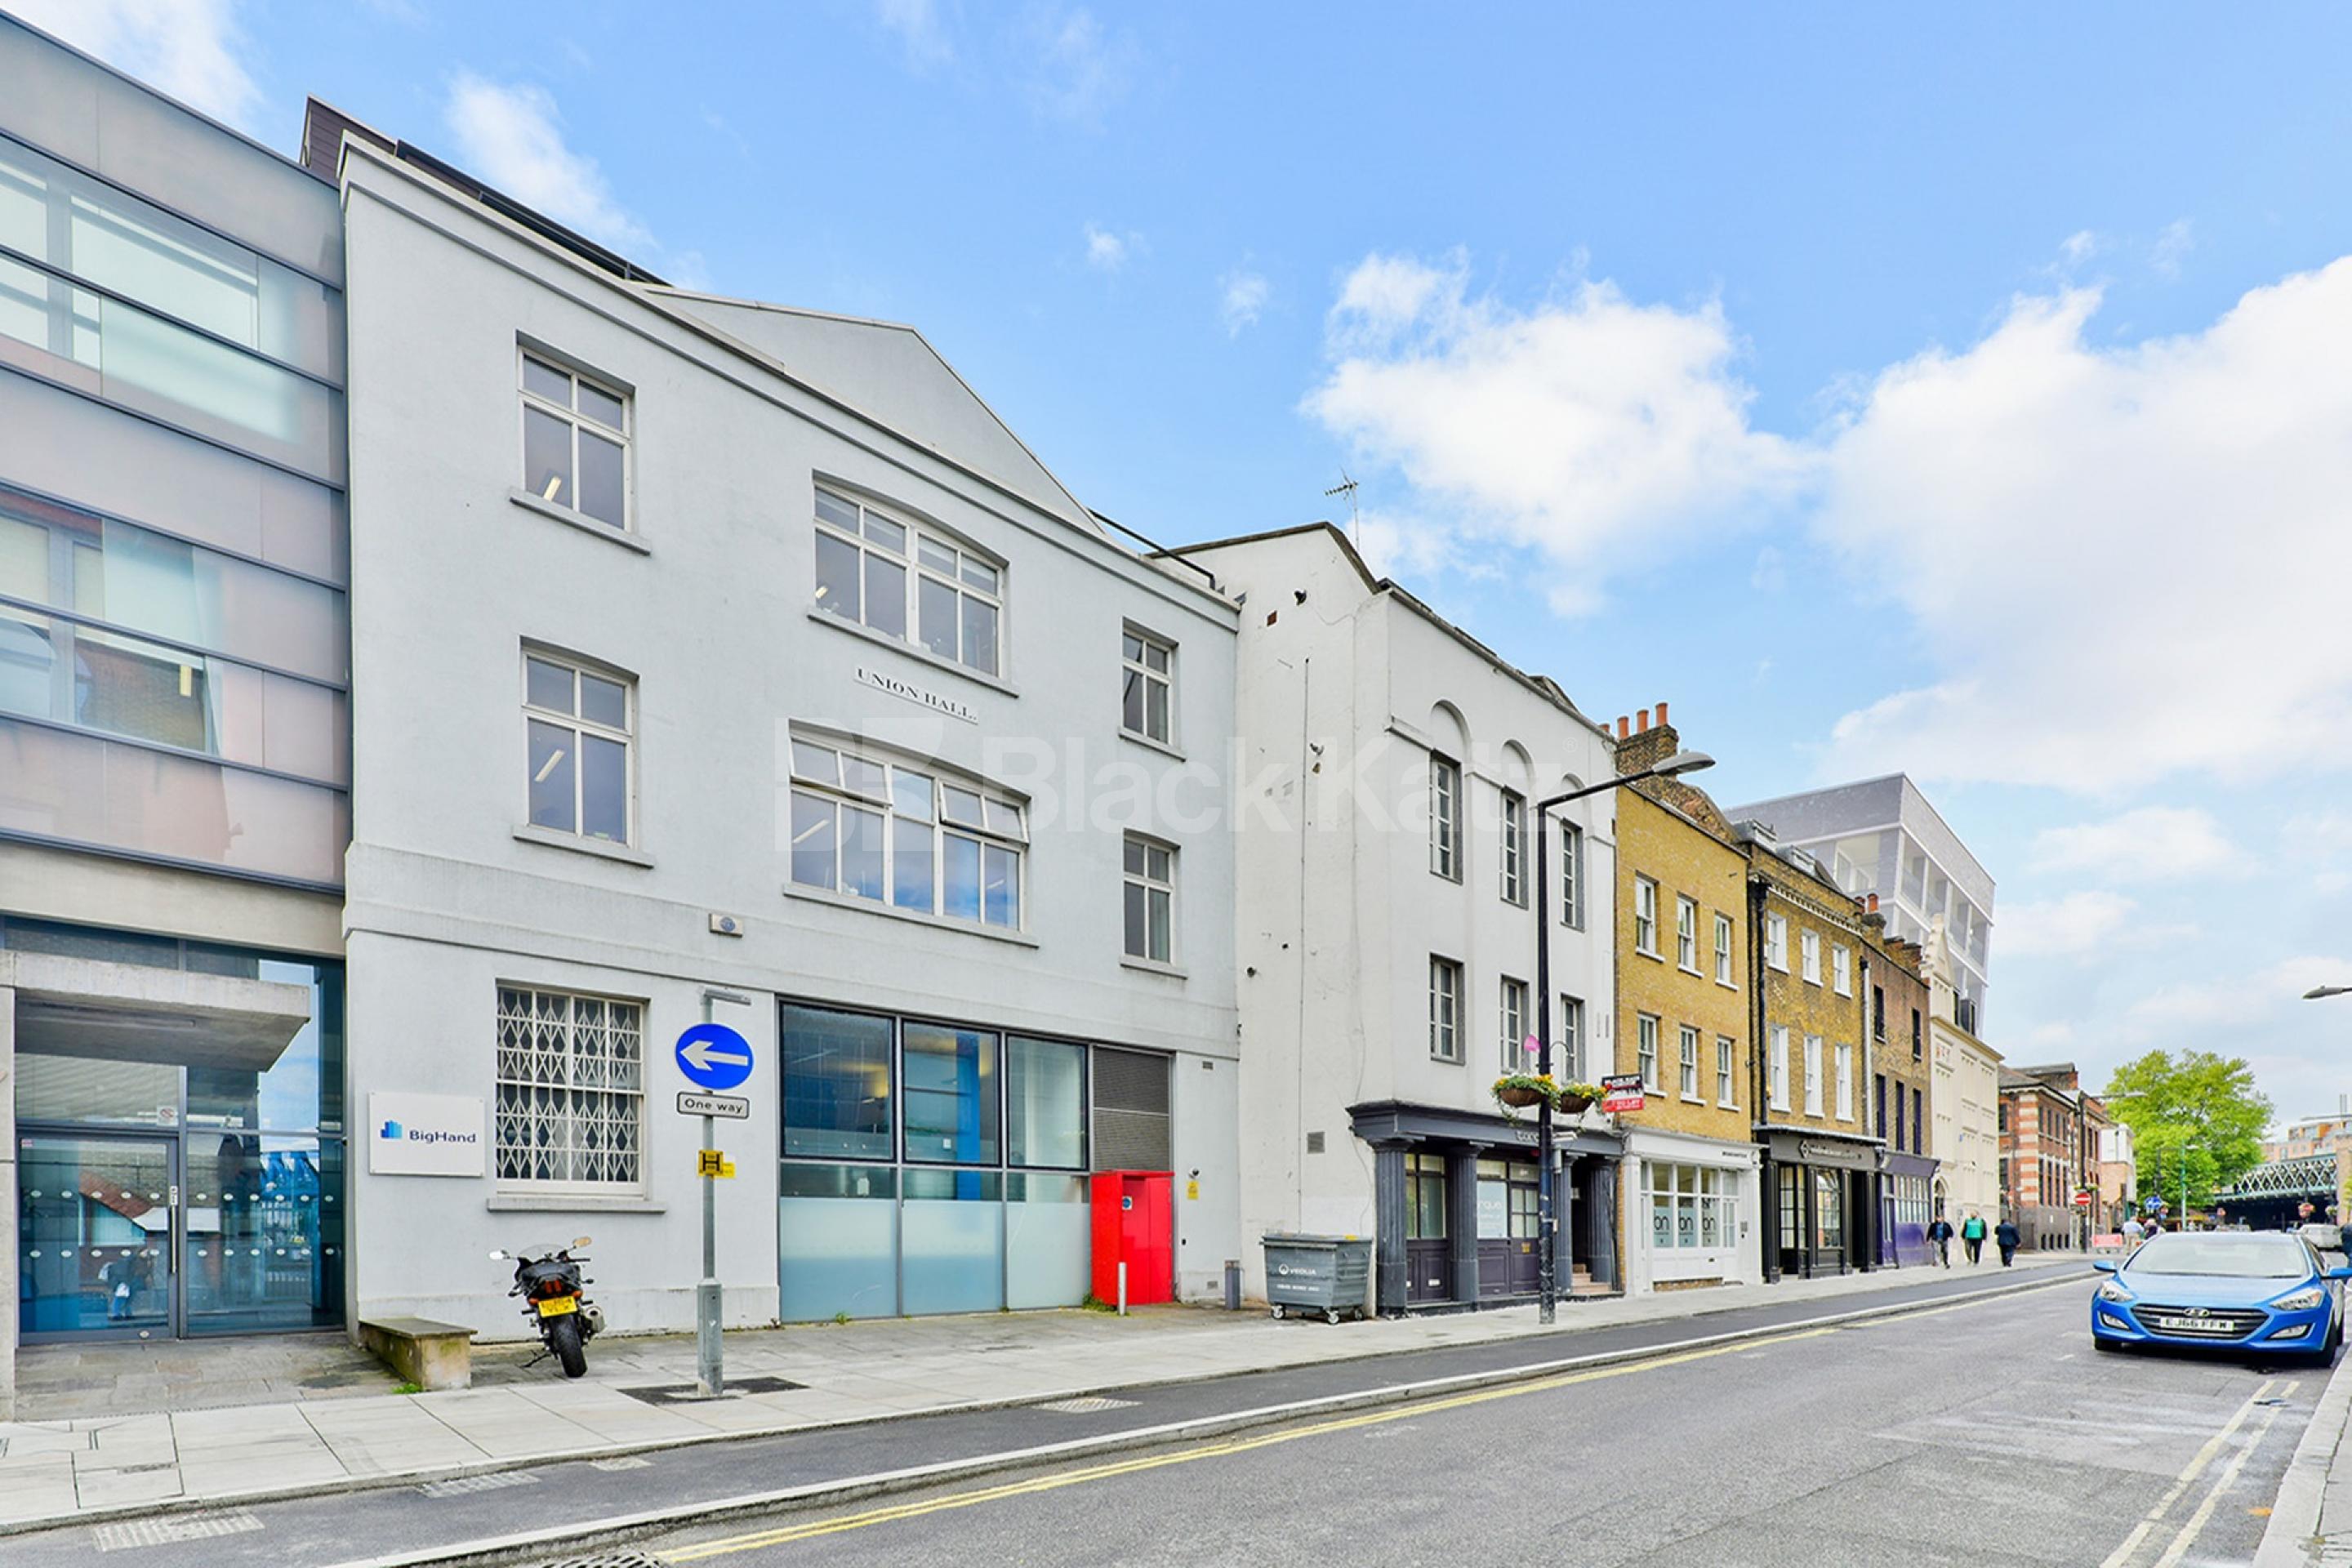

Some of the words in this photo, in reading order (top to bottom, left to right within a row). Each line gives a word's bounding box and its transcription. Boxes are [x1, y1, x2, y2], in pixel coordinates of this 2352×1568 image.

[858, 668, 919, 698] UNION
[684, 1098, 711, 1110] One
[717, 1104, 743, 1114] way
[409, 1129, 476, 1145] BigHand
